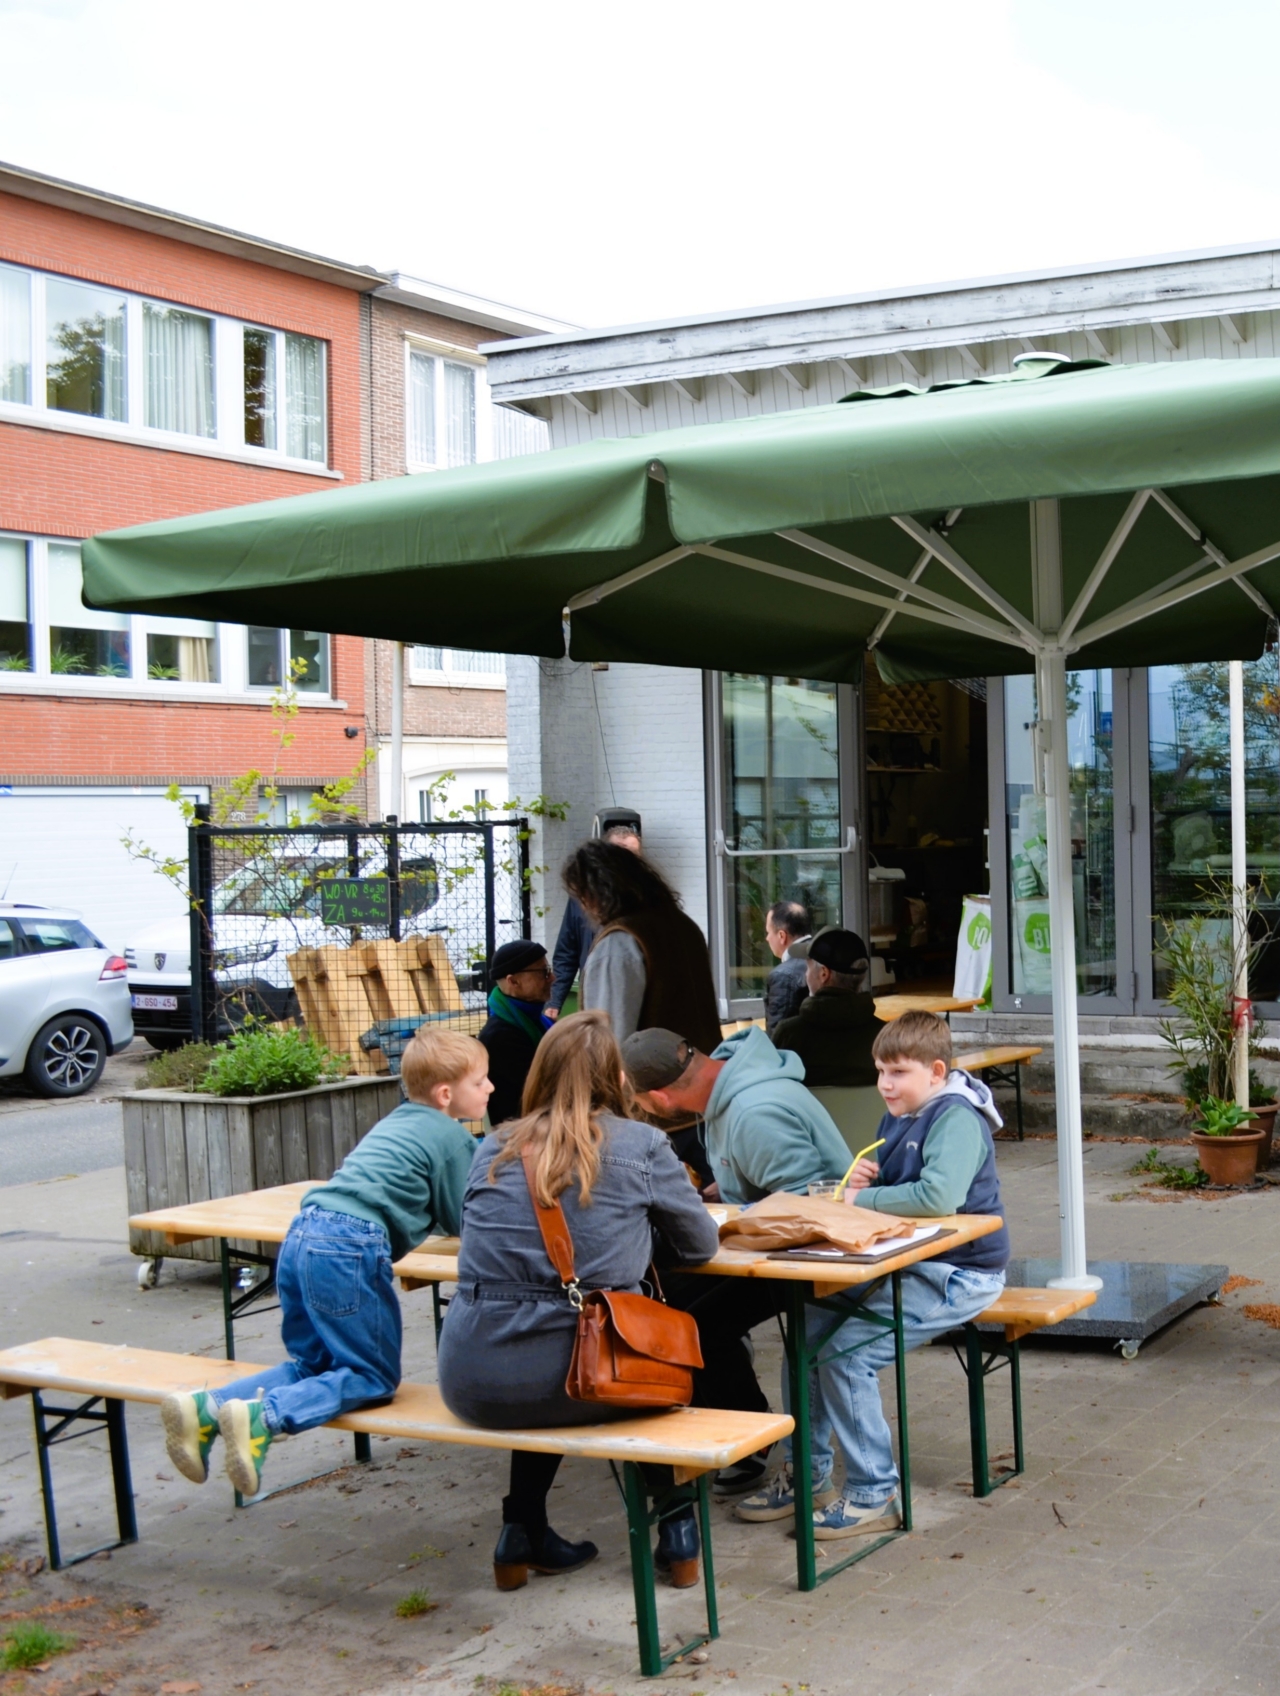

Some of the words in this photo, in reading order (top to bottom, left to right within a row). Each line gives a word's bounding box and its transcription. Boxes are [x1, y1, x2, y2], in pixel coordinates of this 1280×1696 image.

[231, 811, 246, 822] 278
[324, 904, 346, 923] ZA
[1033, 927, 1051, 949] BI
